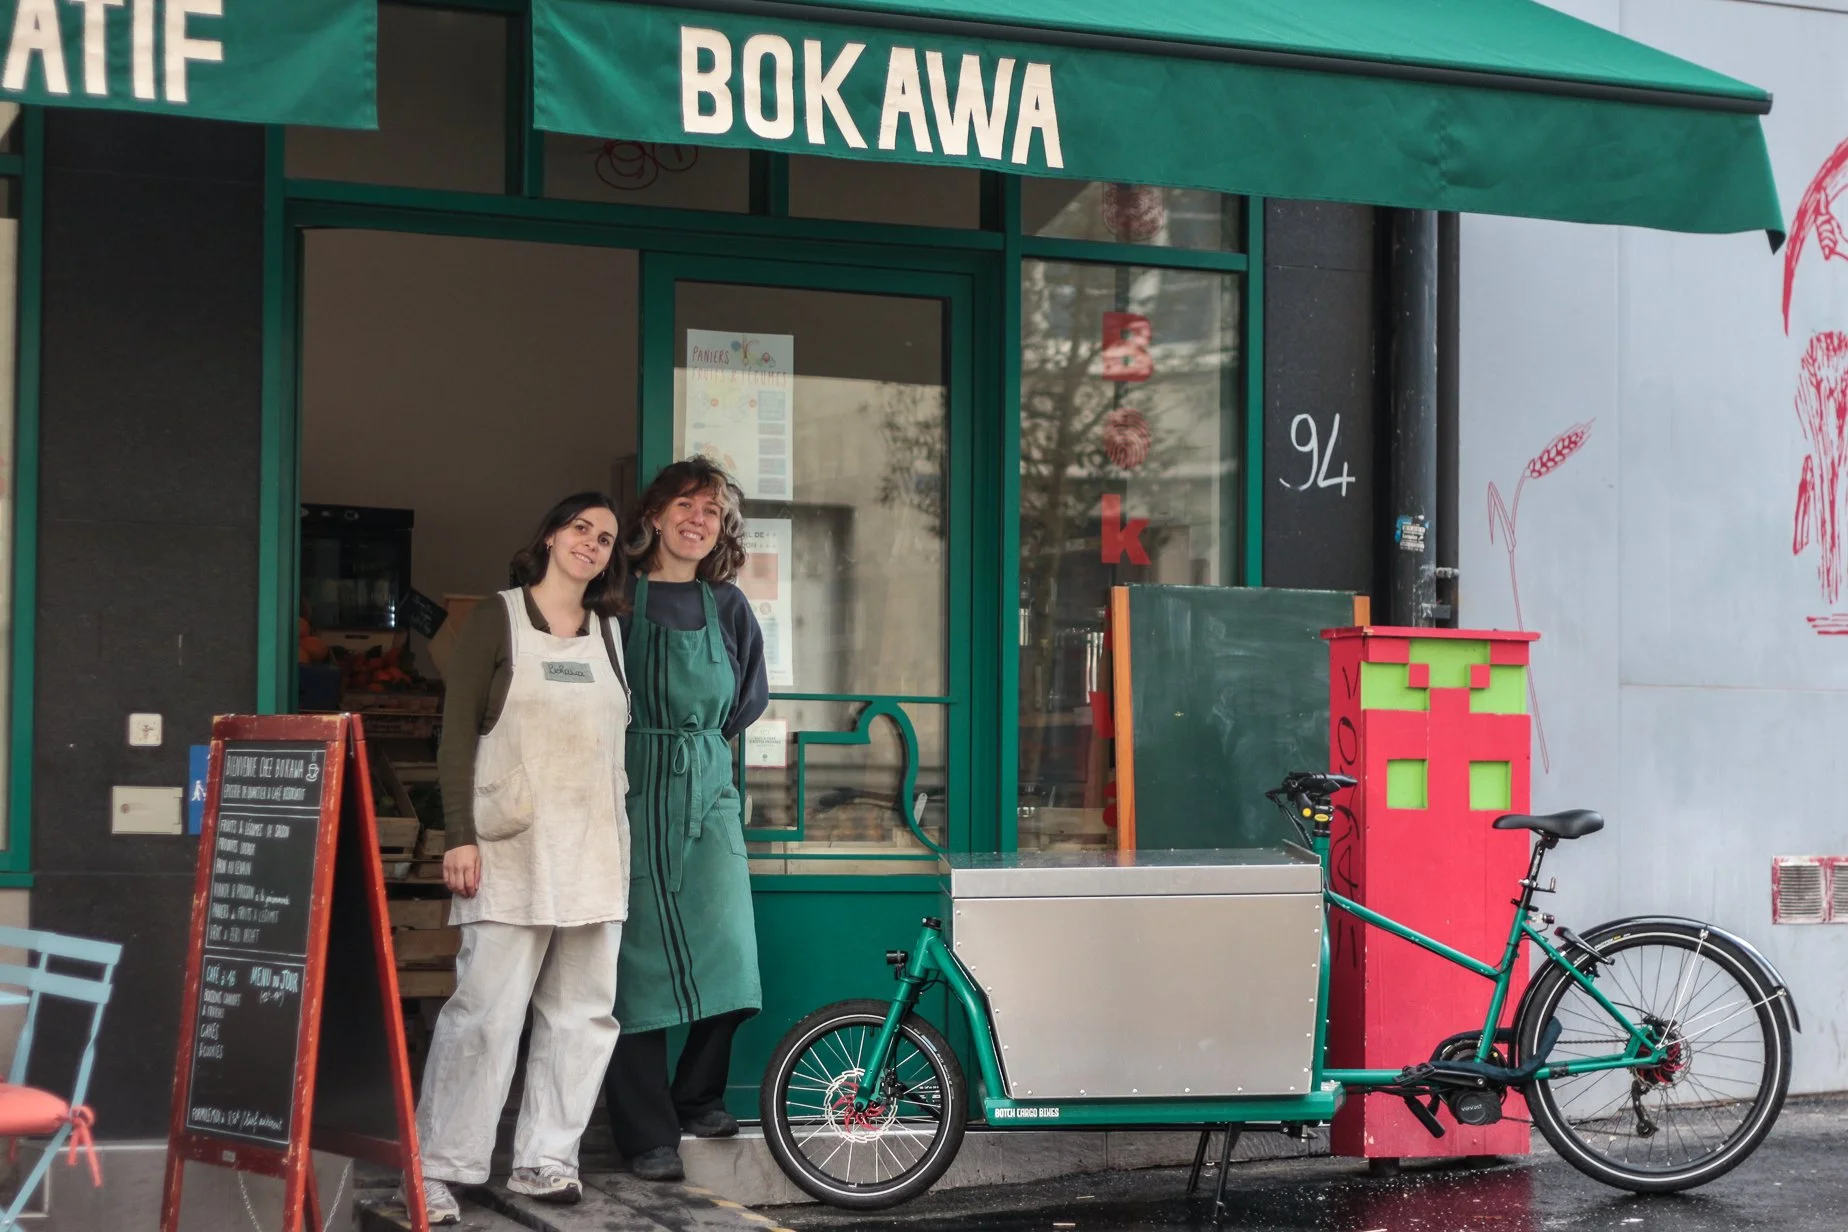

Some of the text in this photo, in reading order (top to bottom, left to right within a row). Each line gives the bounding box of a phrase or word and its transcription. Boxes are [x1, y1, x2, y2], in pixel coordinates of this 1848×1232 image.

[2, 0, 223, 103] ATIF
[680, 25, 1064, 169] BOKAWA
[1279, 412, 1356, 497] 94
[250, 966, 272, 987] MENU
[280, 969, 299, 993] JOUR
[1016, 1108, 1038, 1118] CARGO
[1038, 1108, 1060, 1118] BIKES
